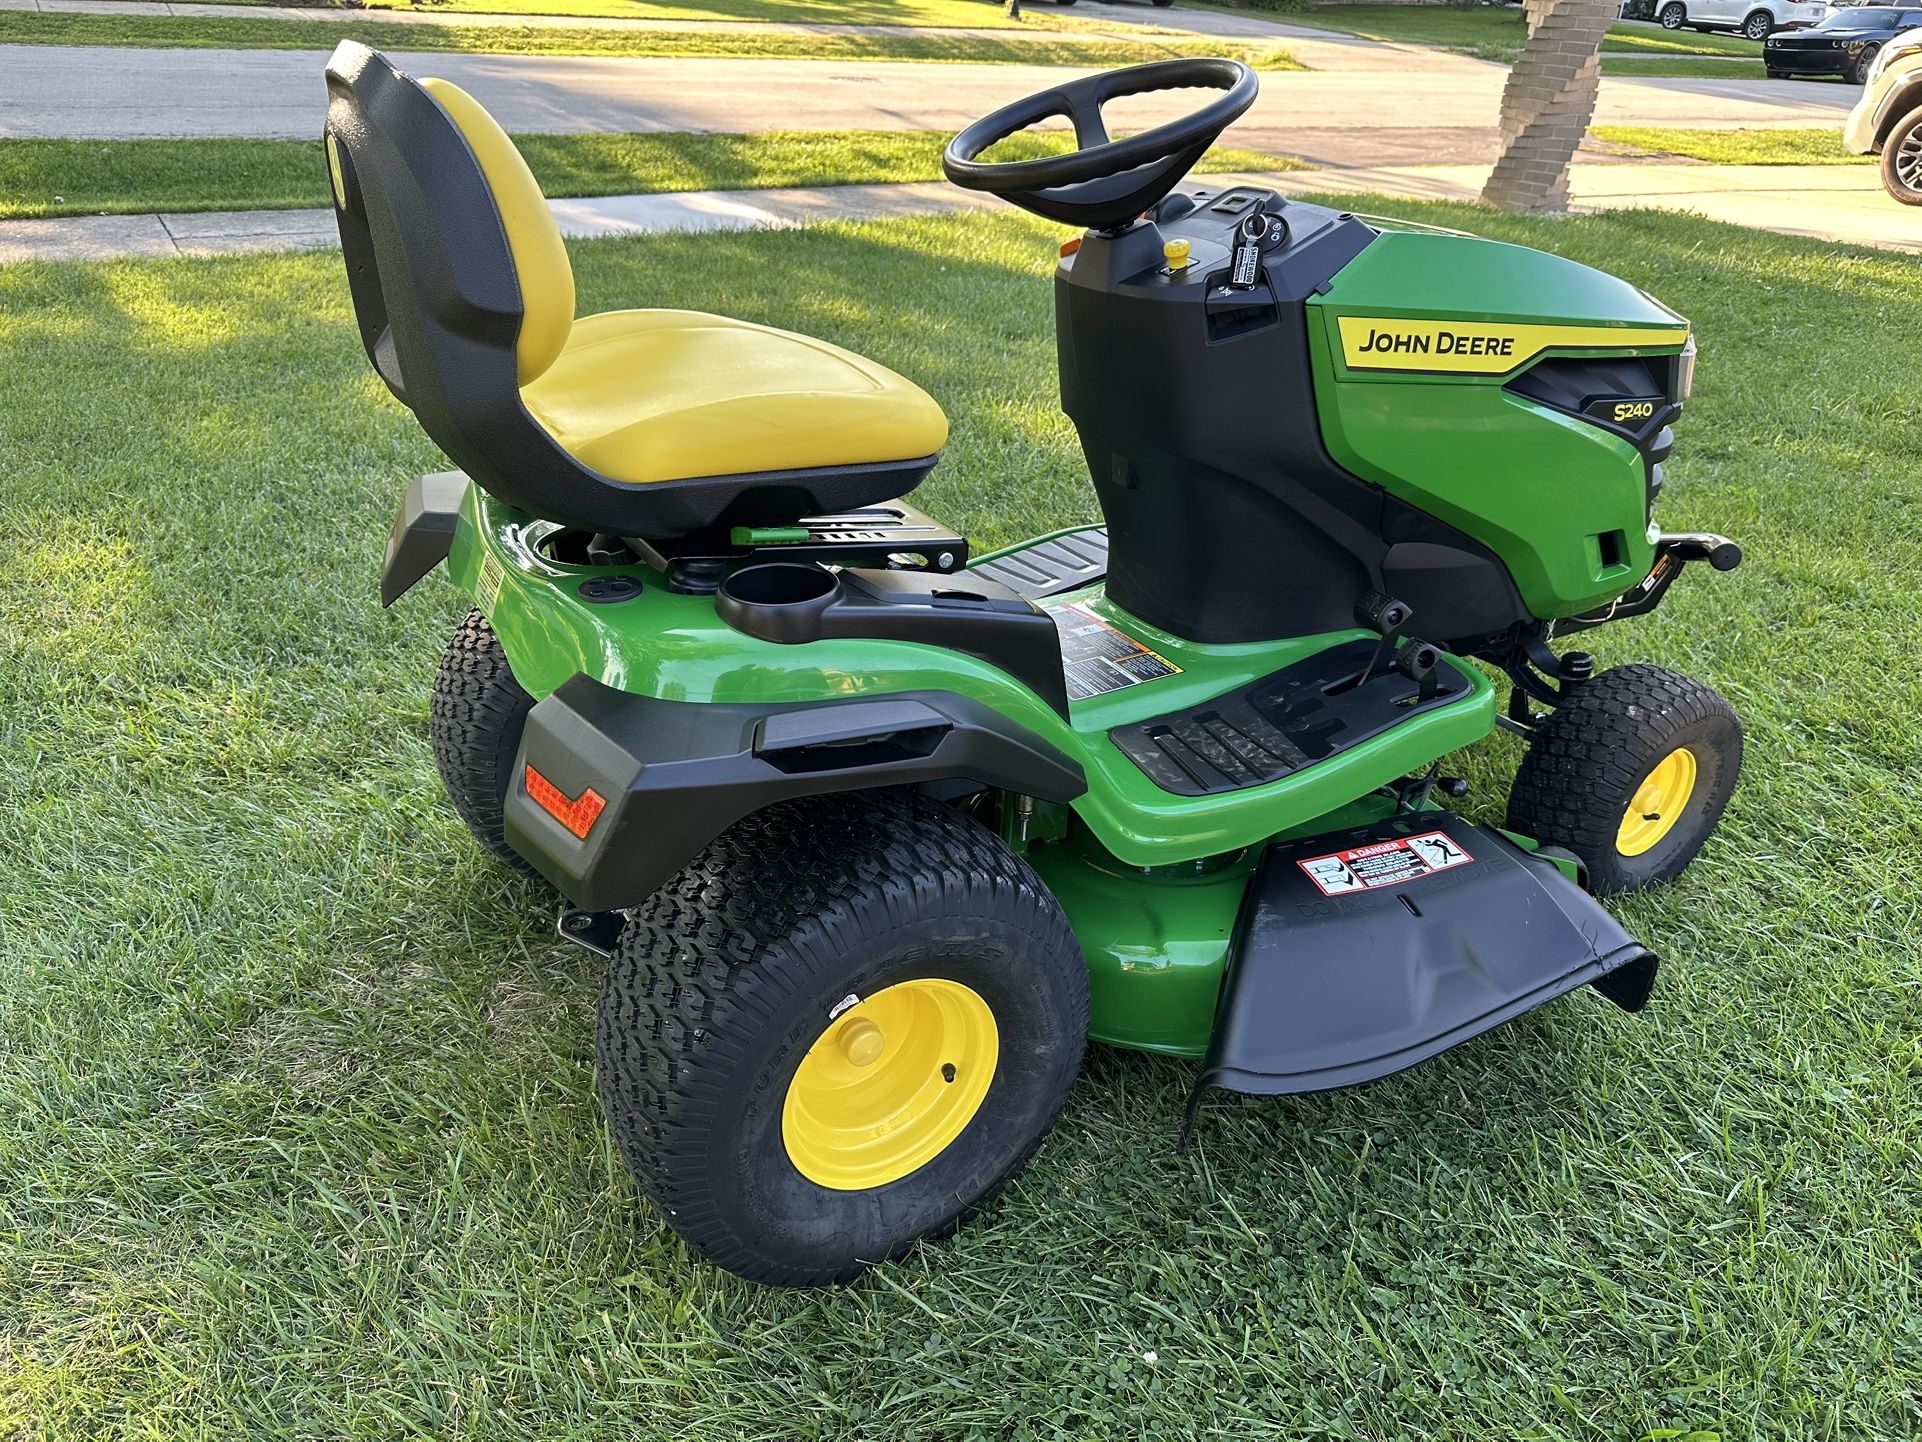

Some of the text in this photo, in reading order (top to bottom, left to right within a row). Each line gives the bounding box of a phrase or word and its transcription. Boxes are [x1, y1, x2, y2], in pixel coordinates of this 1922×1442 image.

[1359, 329, 1515, 356] JOHN DEERE
[1613, 403, 1653, 422] S240
[1357, 842, 1401, 858] DANGER
